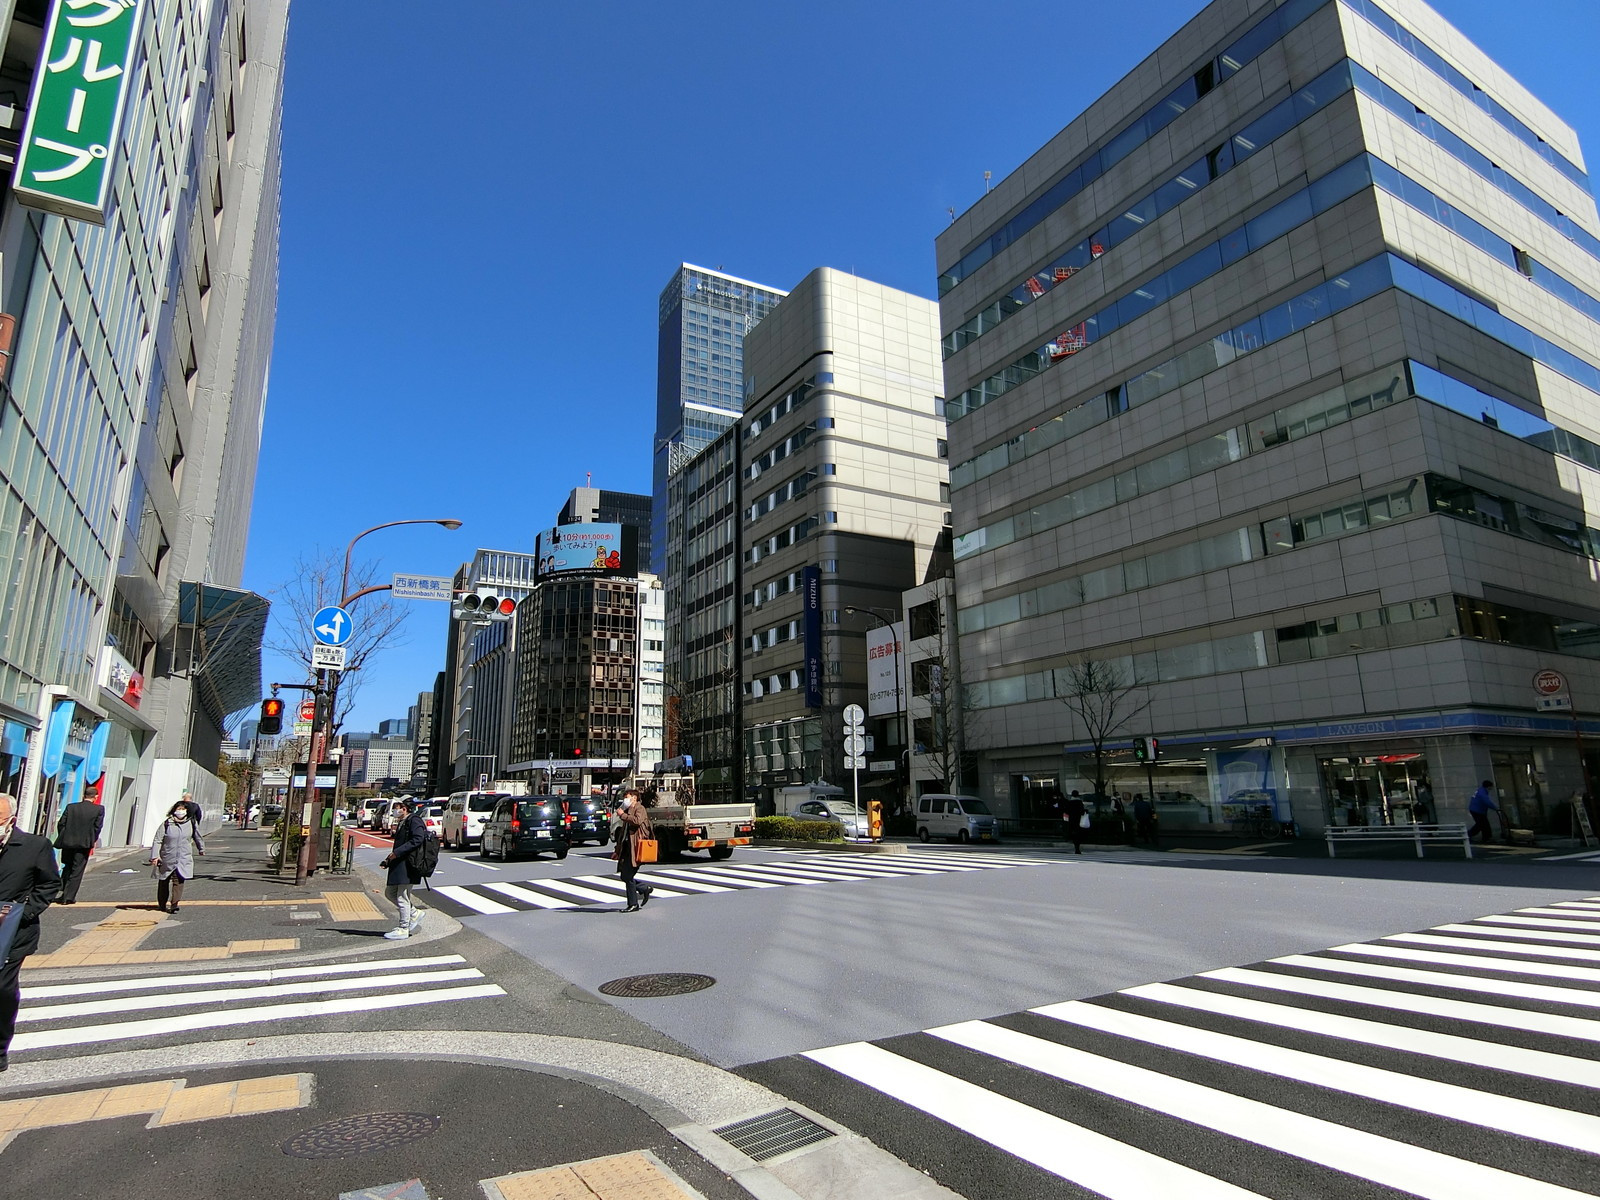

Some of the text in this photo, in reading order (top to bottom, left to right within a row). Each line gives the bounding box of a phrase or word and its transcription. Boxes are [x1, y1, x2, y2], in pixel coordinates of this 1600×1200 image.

[32, 0, 137, 182] グループ
[395, 577, 451, 591] 西新橋第二
[394, 588, 436, 597] Nishishinbashi
[869, 641, 902, 660] 広告募集
[810, 657, 818, 693] みずほ銀行
[1327, 722, 1386, 736] LAWSON
